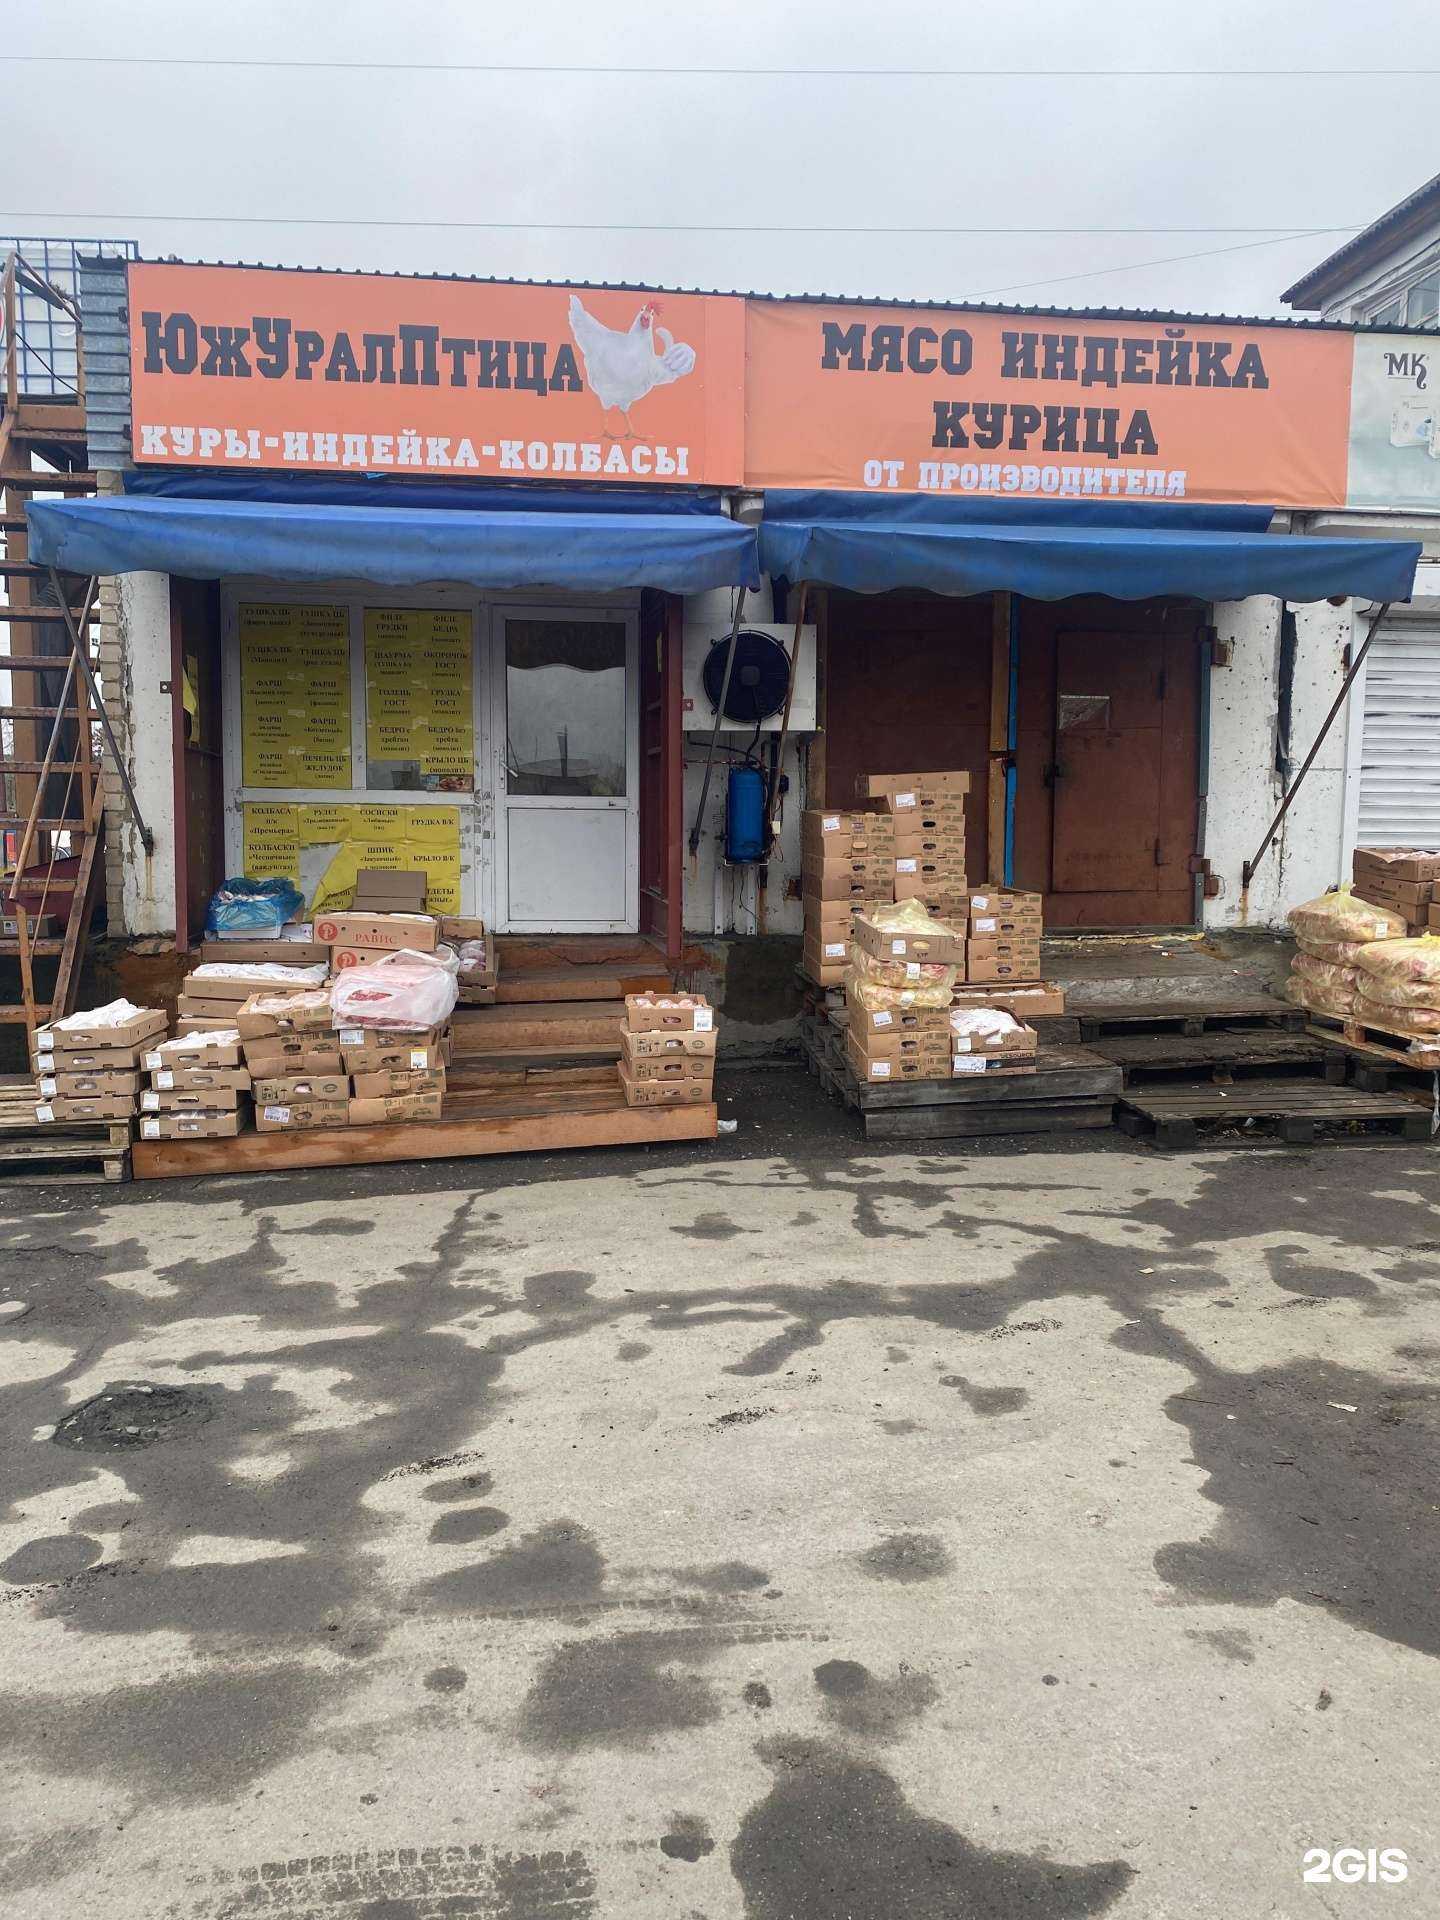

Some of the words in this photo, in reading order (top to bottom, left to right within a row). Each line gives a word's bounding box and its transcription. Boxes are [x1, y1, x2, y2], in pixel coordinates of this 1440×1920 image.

[822, 322, 973, 376] МЯСО
[1001, 328, 1270, 390] ИНДЕЙКА
[931, 401, 1159, 460] КУРИЦА
[141, 425, 689, 476] КУРЫ-ИНДЕЙКА-КОЛБАСЫ
[864, 461, 904, 489] ОТ
[919, 462, 1188, 498] ПРОИЗВОДИТЕЛЯ
[256, 679, 282, 687] ФАРШ
[310, 680, 337, 688] ФАРШ
[431, 689, 461, 697] ГРУДКА
[305, 764, 344, 772] ЖЕЛУДОК
[251, 807, 291, 815] КОЛБАСА
[411, 818, 440, 826] ГРУДКА
[249, 827, 294, 835] «Премьера»
[354, 933, 398, 945] РАВИС
